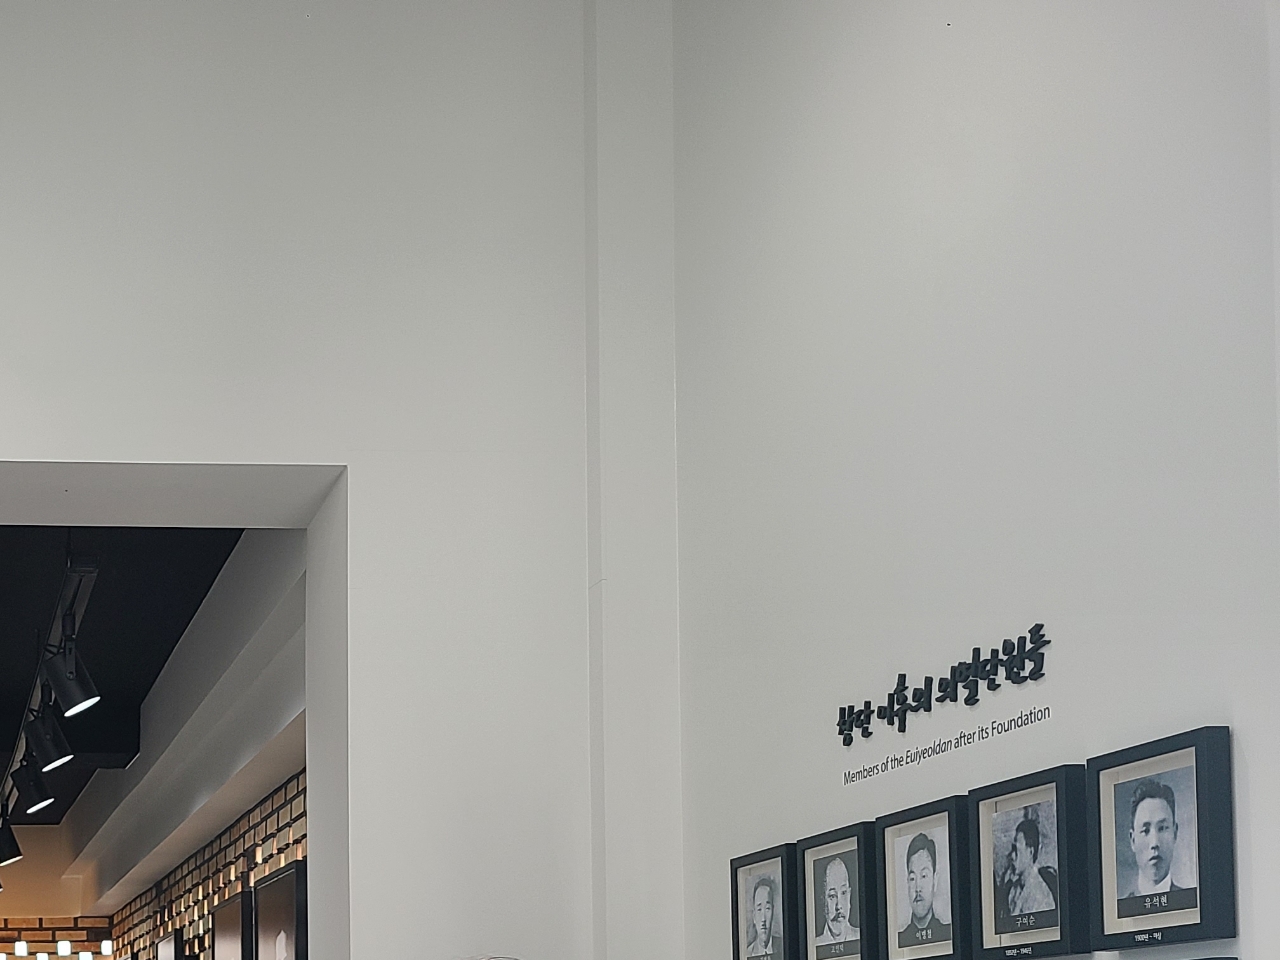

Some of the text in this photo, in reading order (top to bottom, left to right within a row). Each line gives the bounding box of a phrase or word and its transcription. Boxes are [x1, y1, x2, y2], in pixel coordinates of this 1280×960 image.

[877, 674, 934, 733] 이후의
[935, 624, 1052, 706] 의열단원들
[843, 705, 1051, 786] Members of the Euiyeoldan after its Foundation
[1015, 915, 1036, 927] 구여순
[1143, 894, 1168, 909] 유석현
